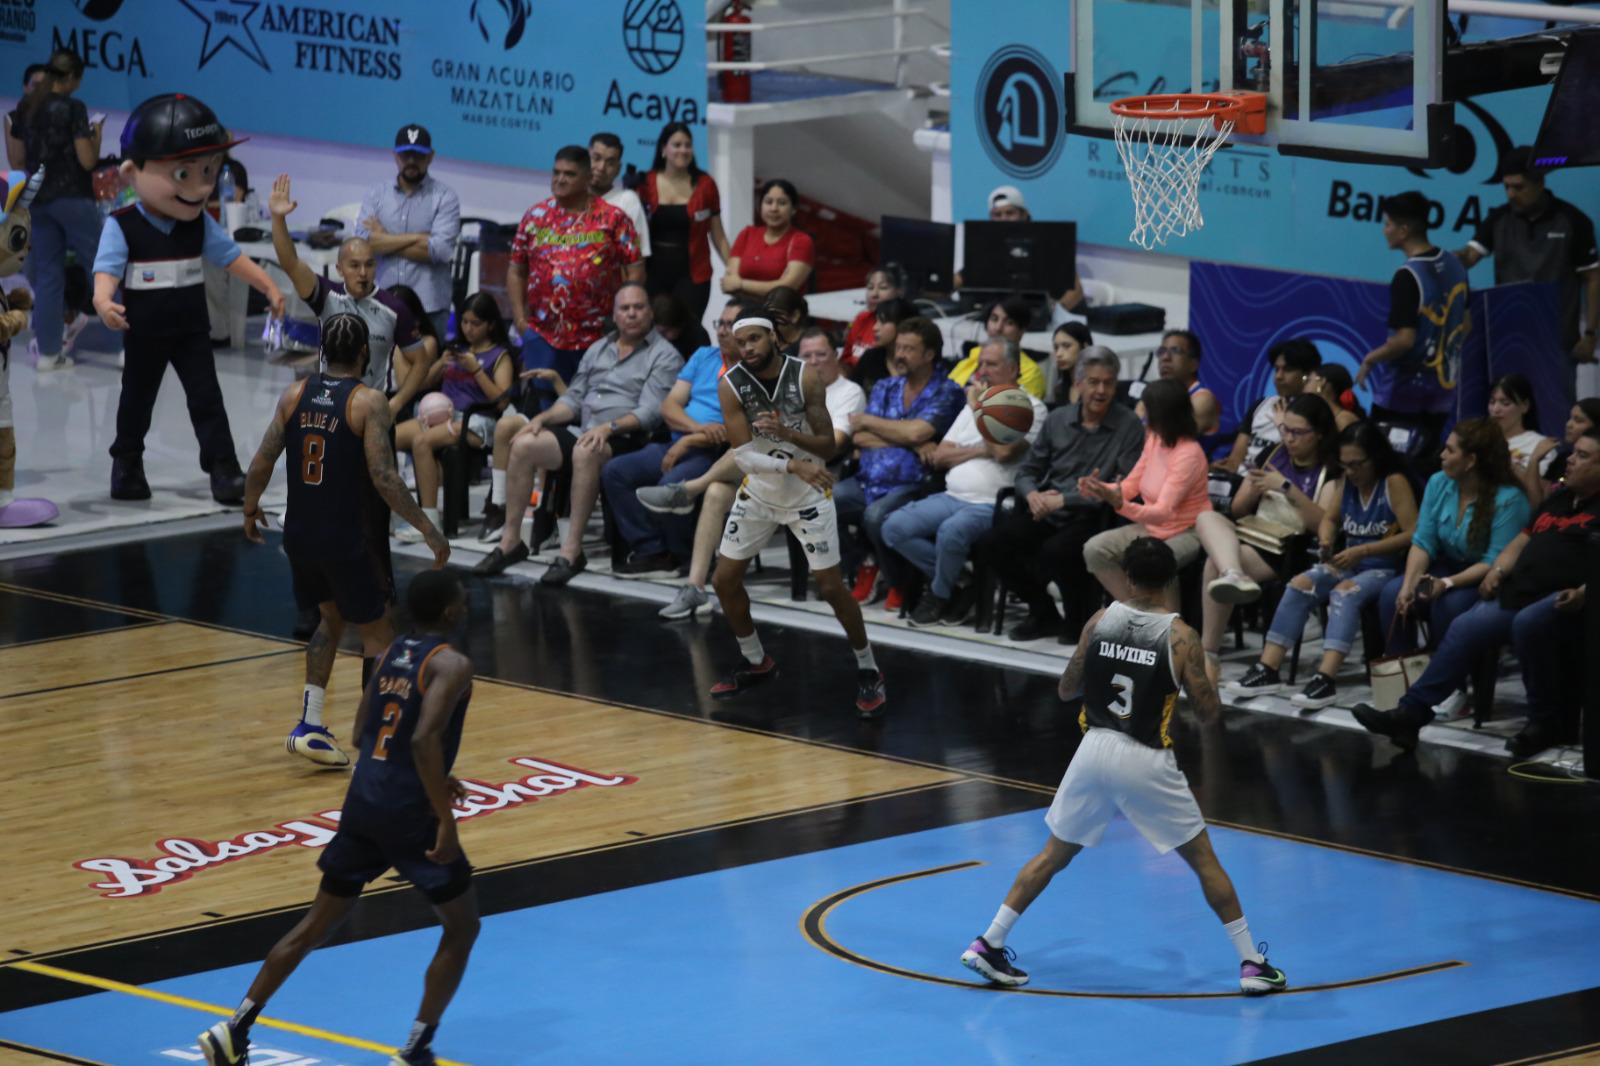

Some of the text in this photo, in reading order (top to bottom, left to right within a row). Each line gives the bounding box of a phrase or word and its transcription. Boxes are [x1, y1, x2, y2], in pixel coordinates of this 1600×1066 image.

[260, 4, 401, 46] AMERICAN
[51, 24, 147, 79] MEGA
[294, 41, 403, 81] FITNESS
[432, 58, 575, 93] GRAN ACUARIO
[1087, 141, 1271, 183] RRTS
[1327, 179, 1445, 231] Bano
[300, 411, 328, 429] BLUE
[302, 433, 326, 487] 8
[1098, 640, 1158, 667] DAWKINS
[1106, 672, 1135, 720] 3
[371, 701, 403, 762] 2
[78, 830, 297, 899] Salsa
